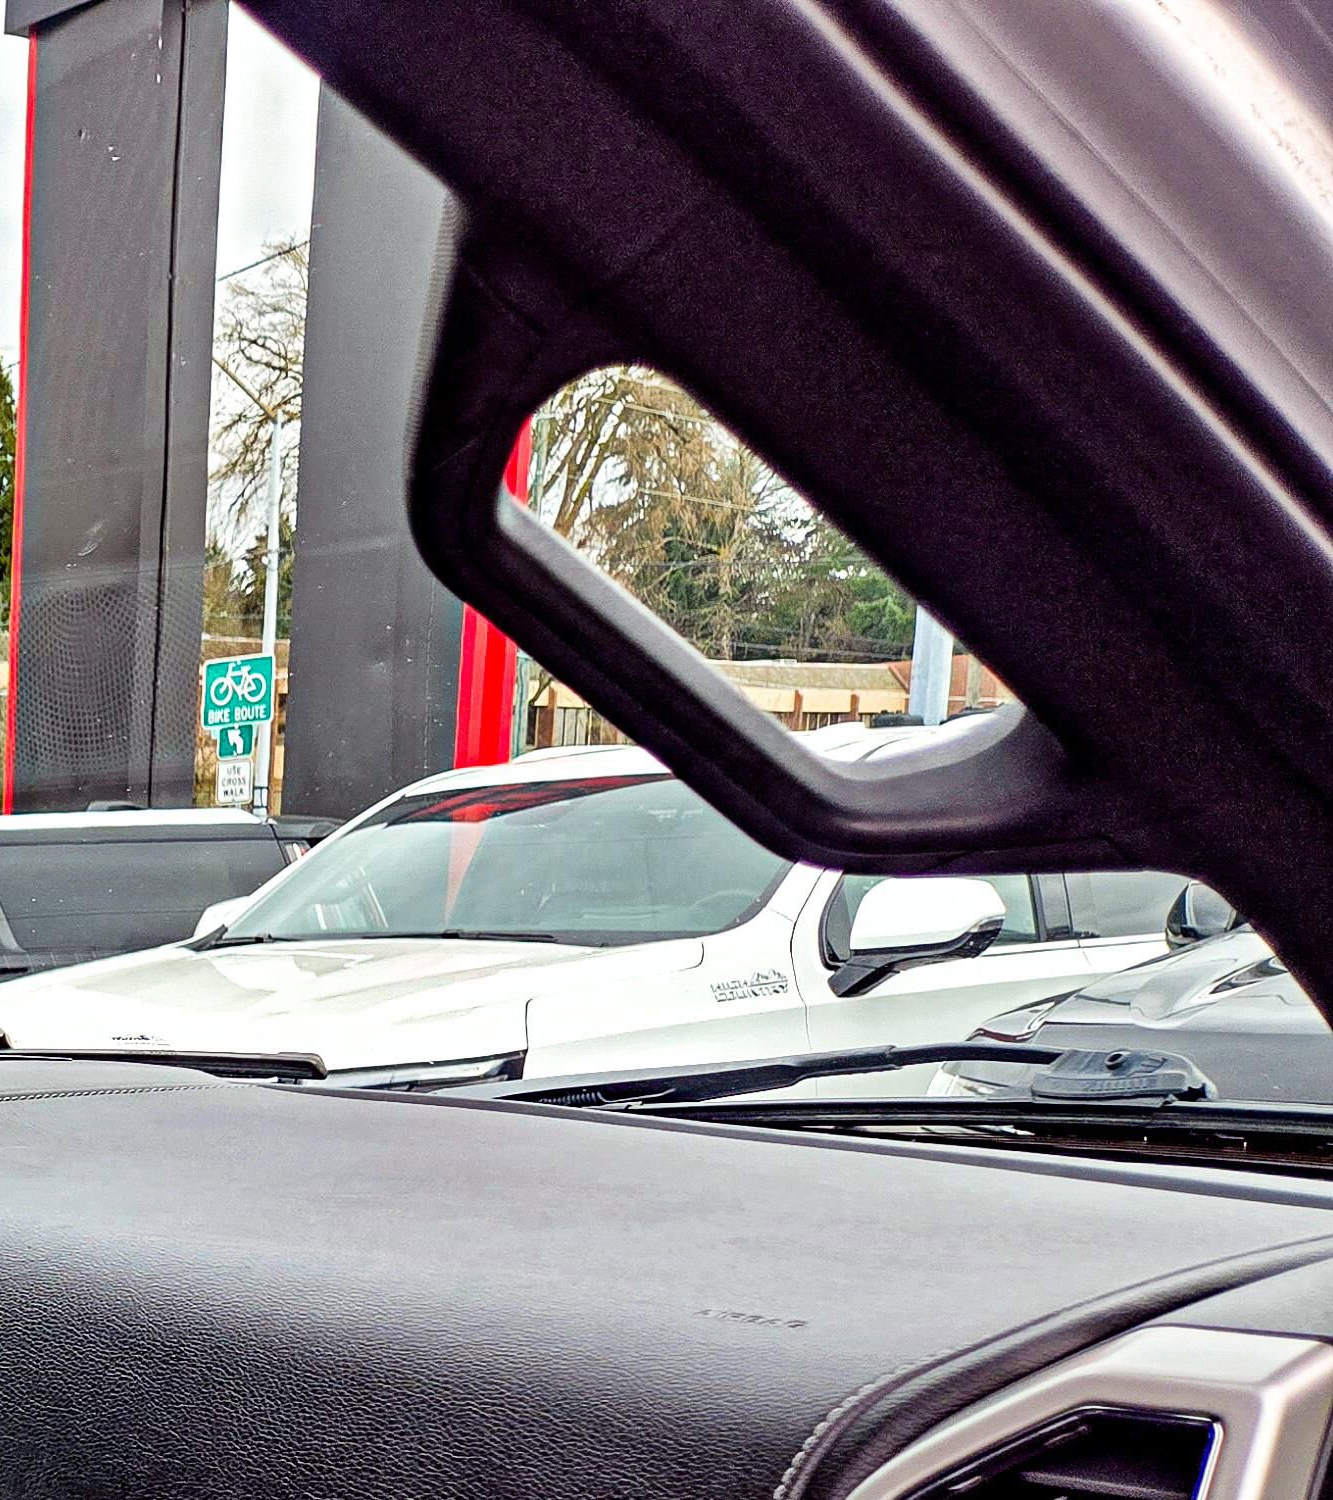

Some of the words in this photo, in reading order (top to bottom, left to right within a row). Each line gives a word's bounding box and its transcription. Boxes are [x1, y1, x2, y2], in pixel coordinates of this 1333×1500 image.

[208, 708, 230, 724] BIKE
[234, 705, 267, 721] ROUTE
[226, 766, 242, 775] USE
[221, 777, 246, 786] CROSS
[223, 789, 244, 797] WALK
